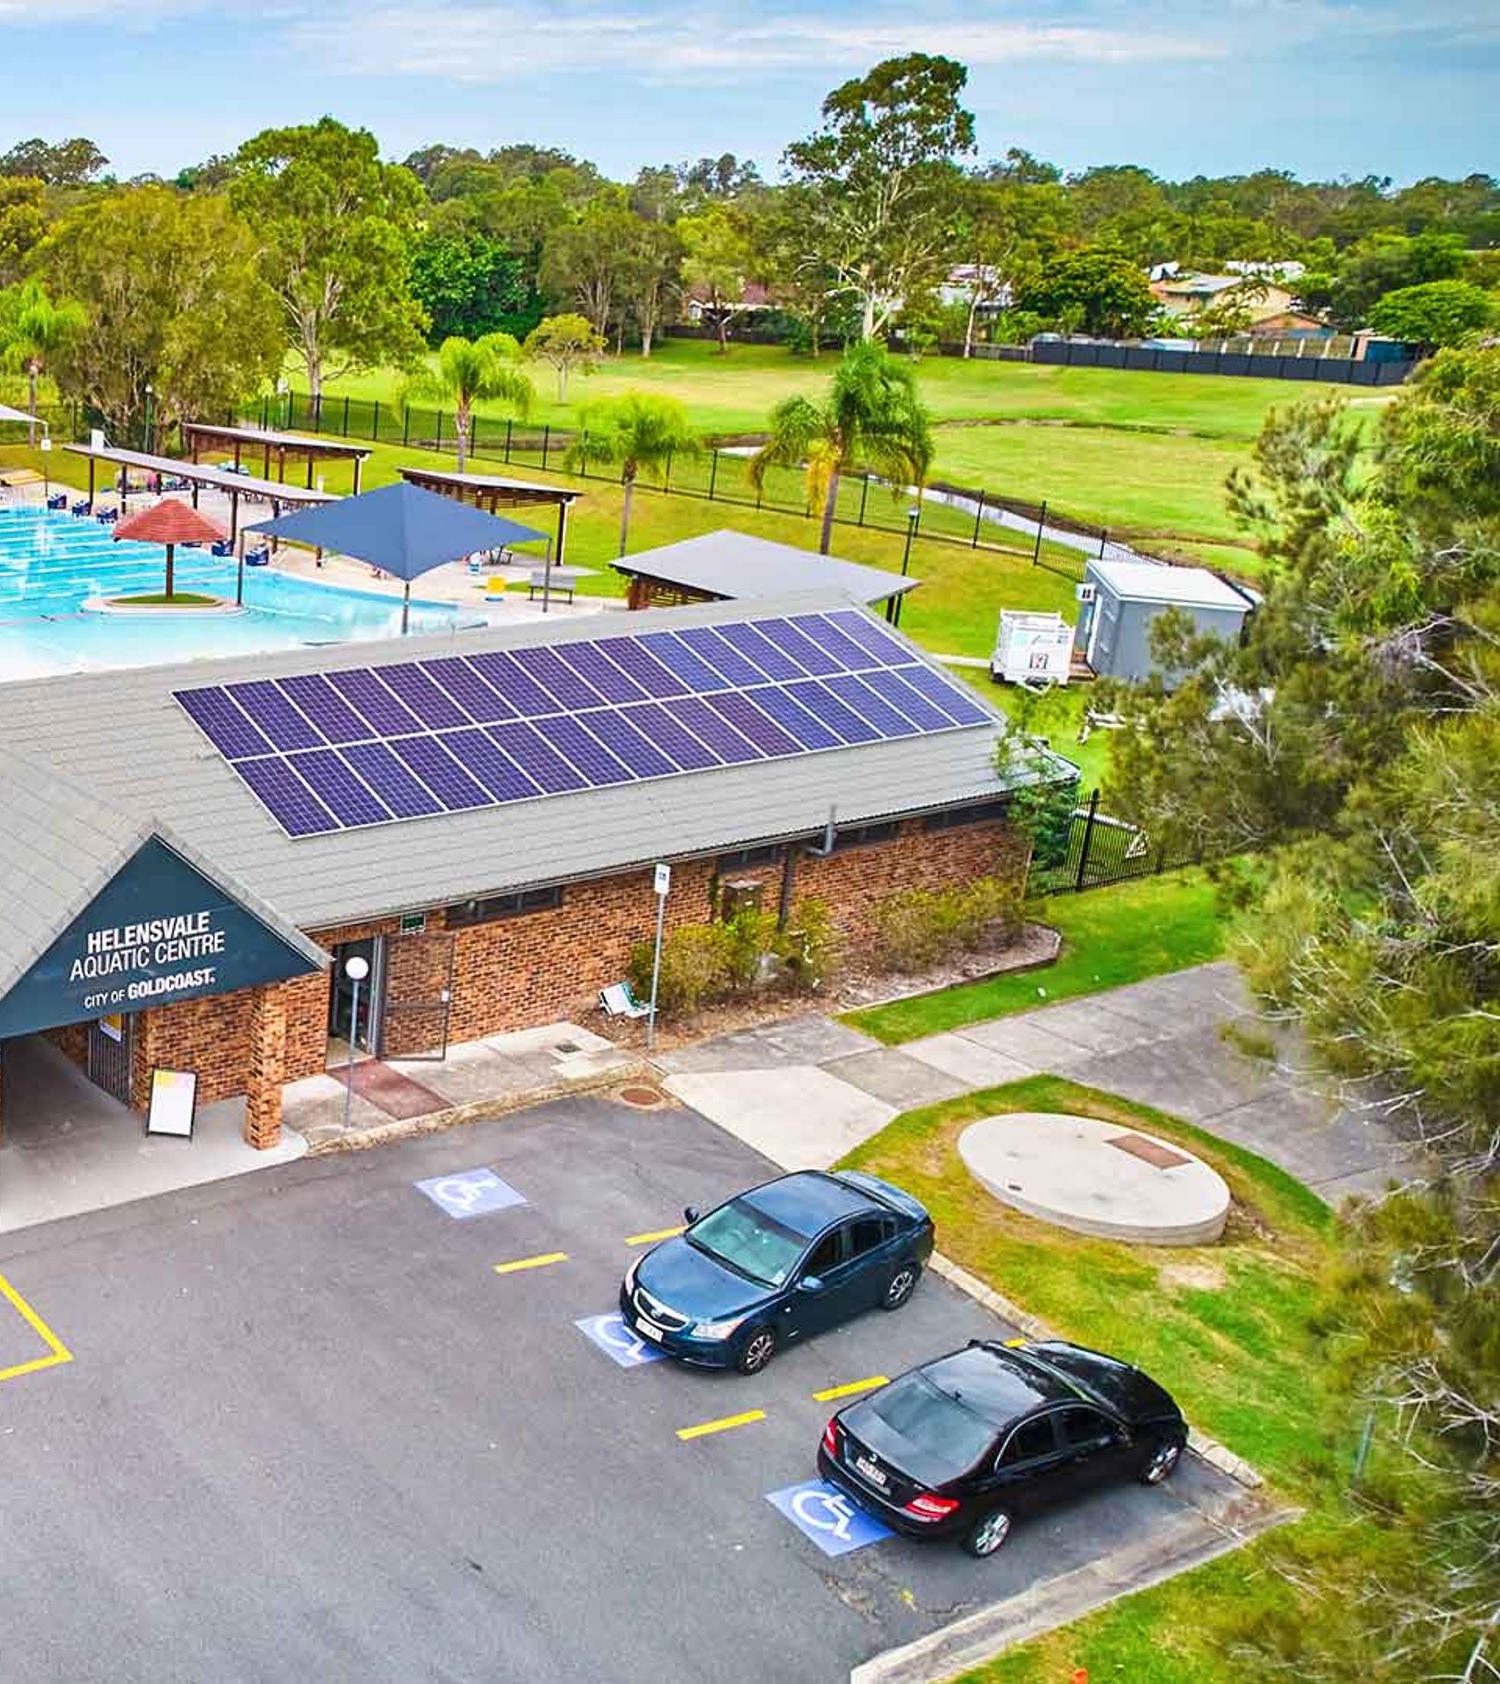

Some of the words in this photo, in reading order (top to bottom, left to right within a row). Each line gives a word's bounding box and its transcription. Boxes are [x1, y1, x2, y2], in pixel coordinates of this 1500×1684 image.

[87, 911, 210, 954] HELENSVALE
[69, 945, 150, 981] AQUATIC
[154, 931, 225, 964] CENTRE
[84, 992, 108, 1009] CITY
[111, 989, 126, 1004] OF
